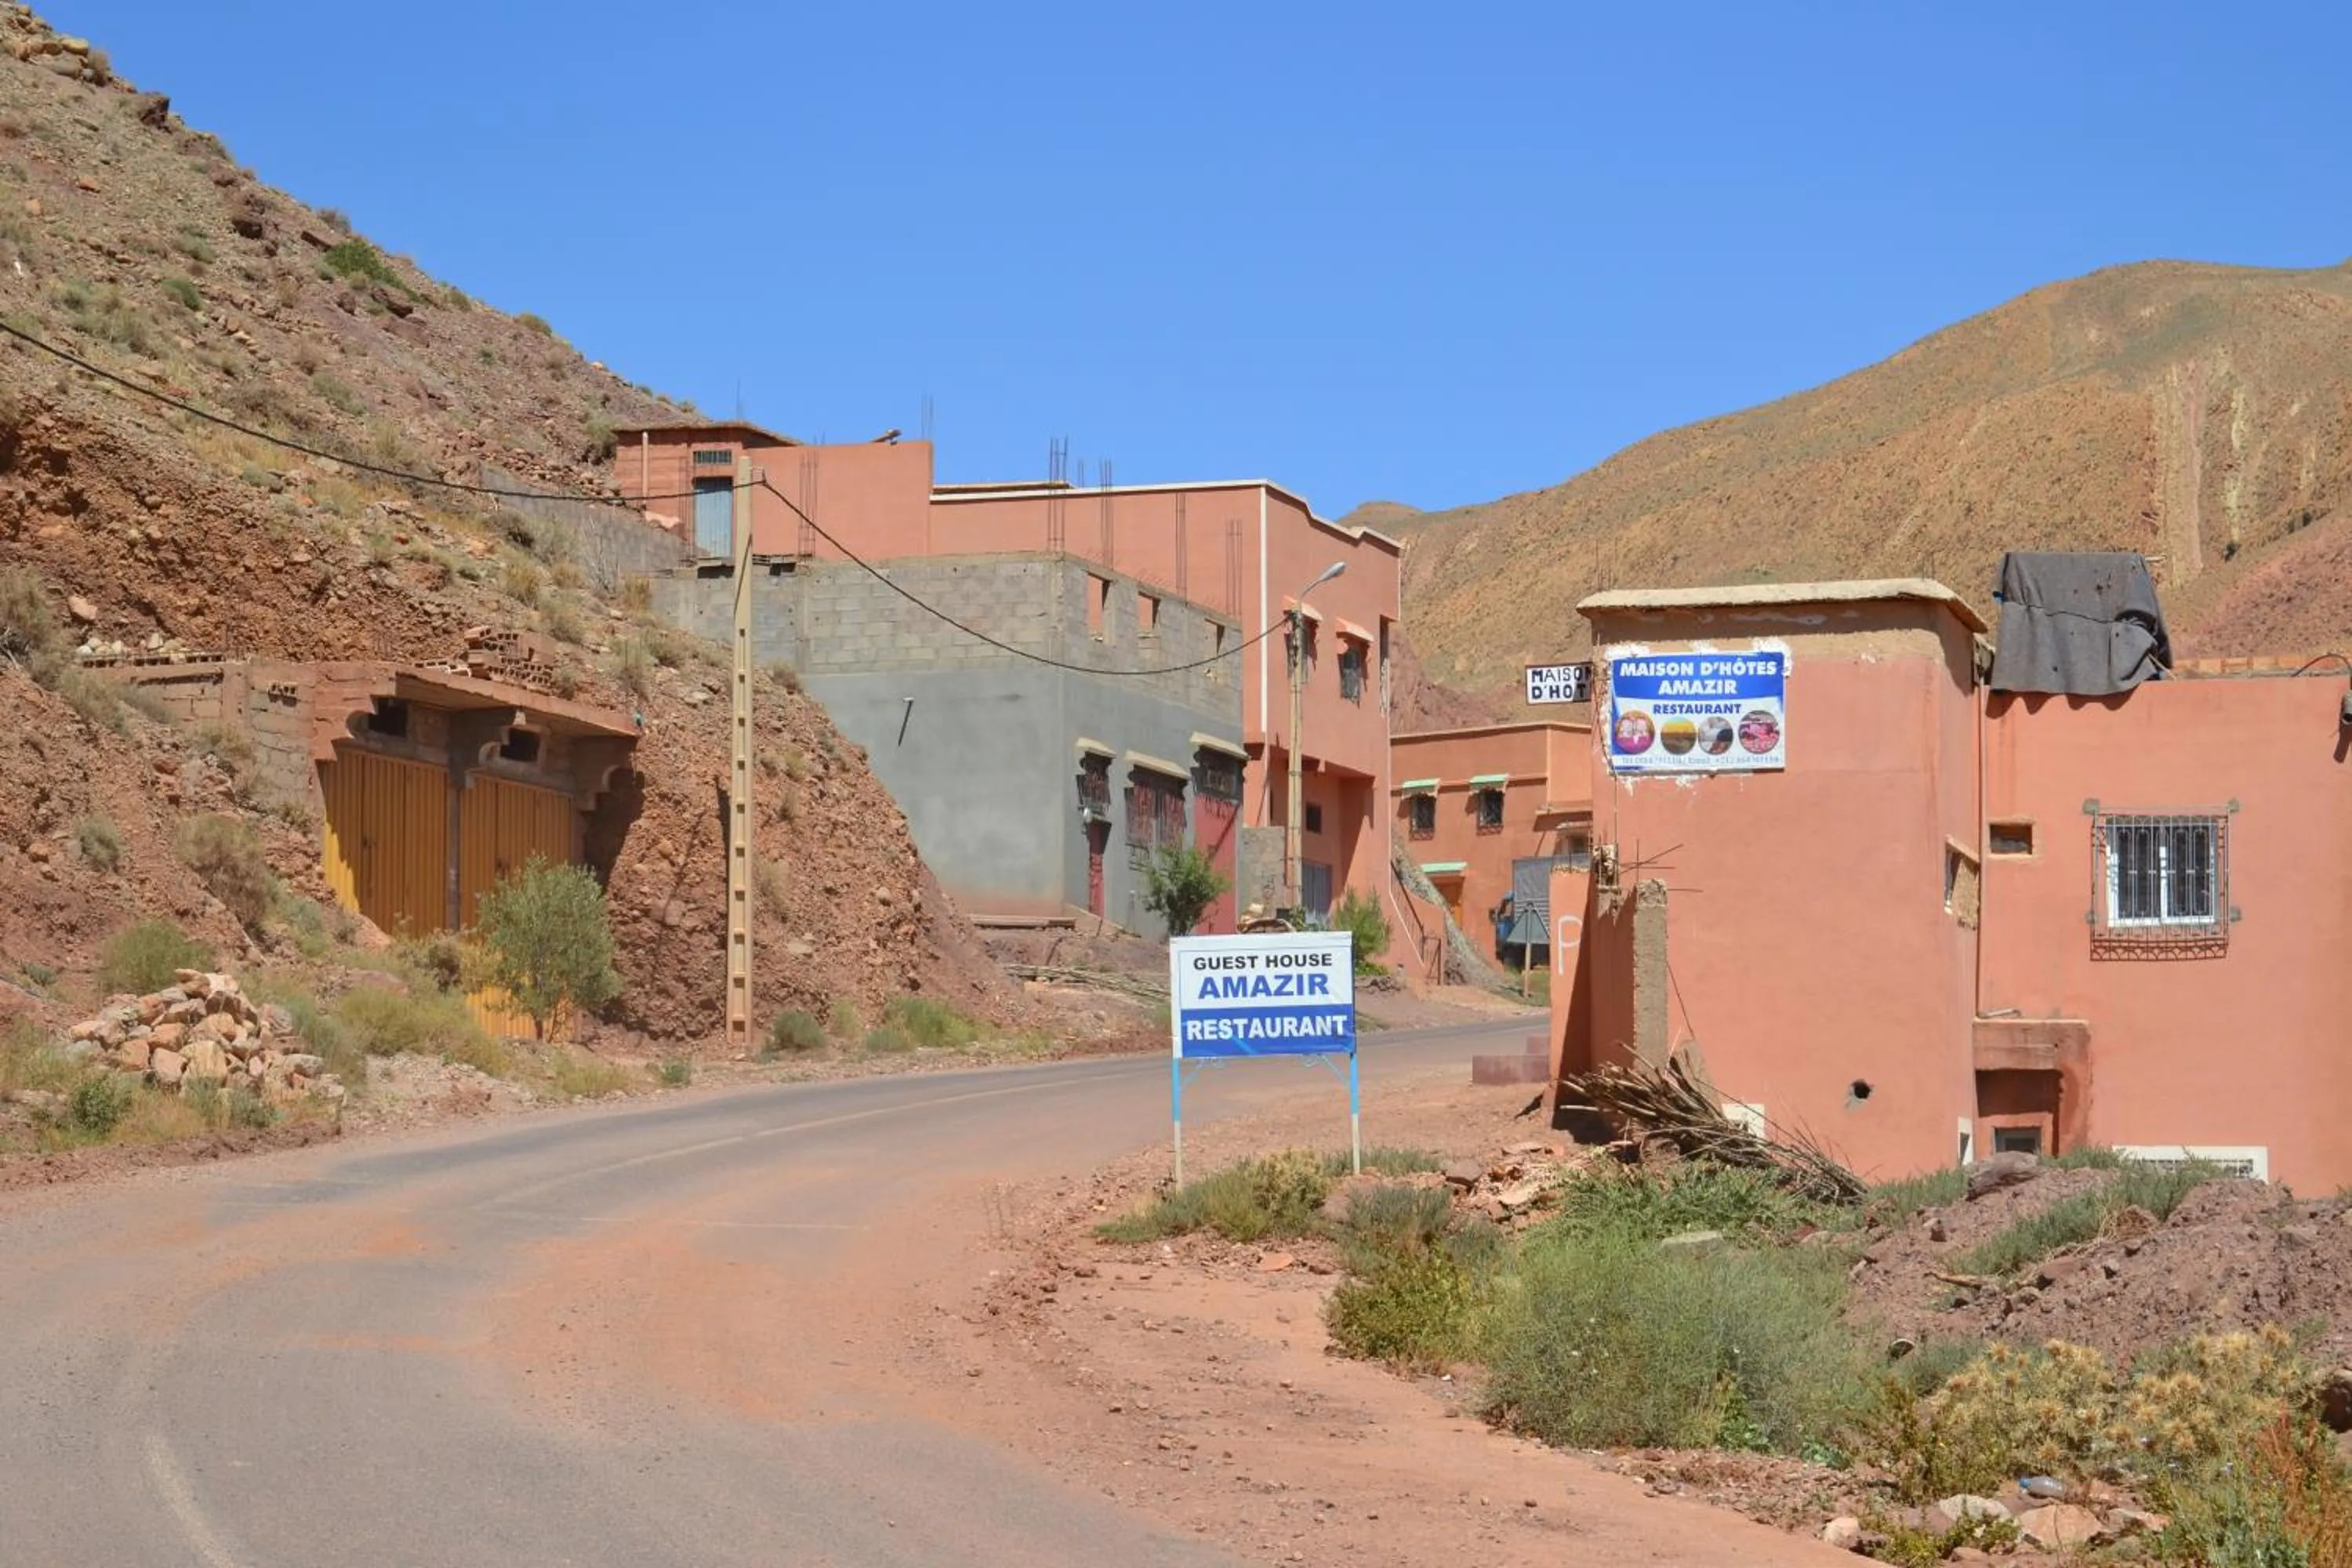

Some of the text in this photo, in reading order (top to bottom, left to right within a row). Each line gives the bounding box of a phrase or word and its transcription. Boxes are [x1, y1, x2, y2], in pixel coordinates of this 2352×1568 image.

[1620, 658, 1777, 677] MAISON D'HÔTES
[1658, 679, 1737, 695] AMAZIR
[1653, 703, 1741, 715] RESTAURANT
[1193, 953, 1332, 970] GUEST HOUSE
[1199, 974, 1329, 999] AMAZIR
[1187, 1015, 1347, 1040] RESTAURANT
